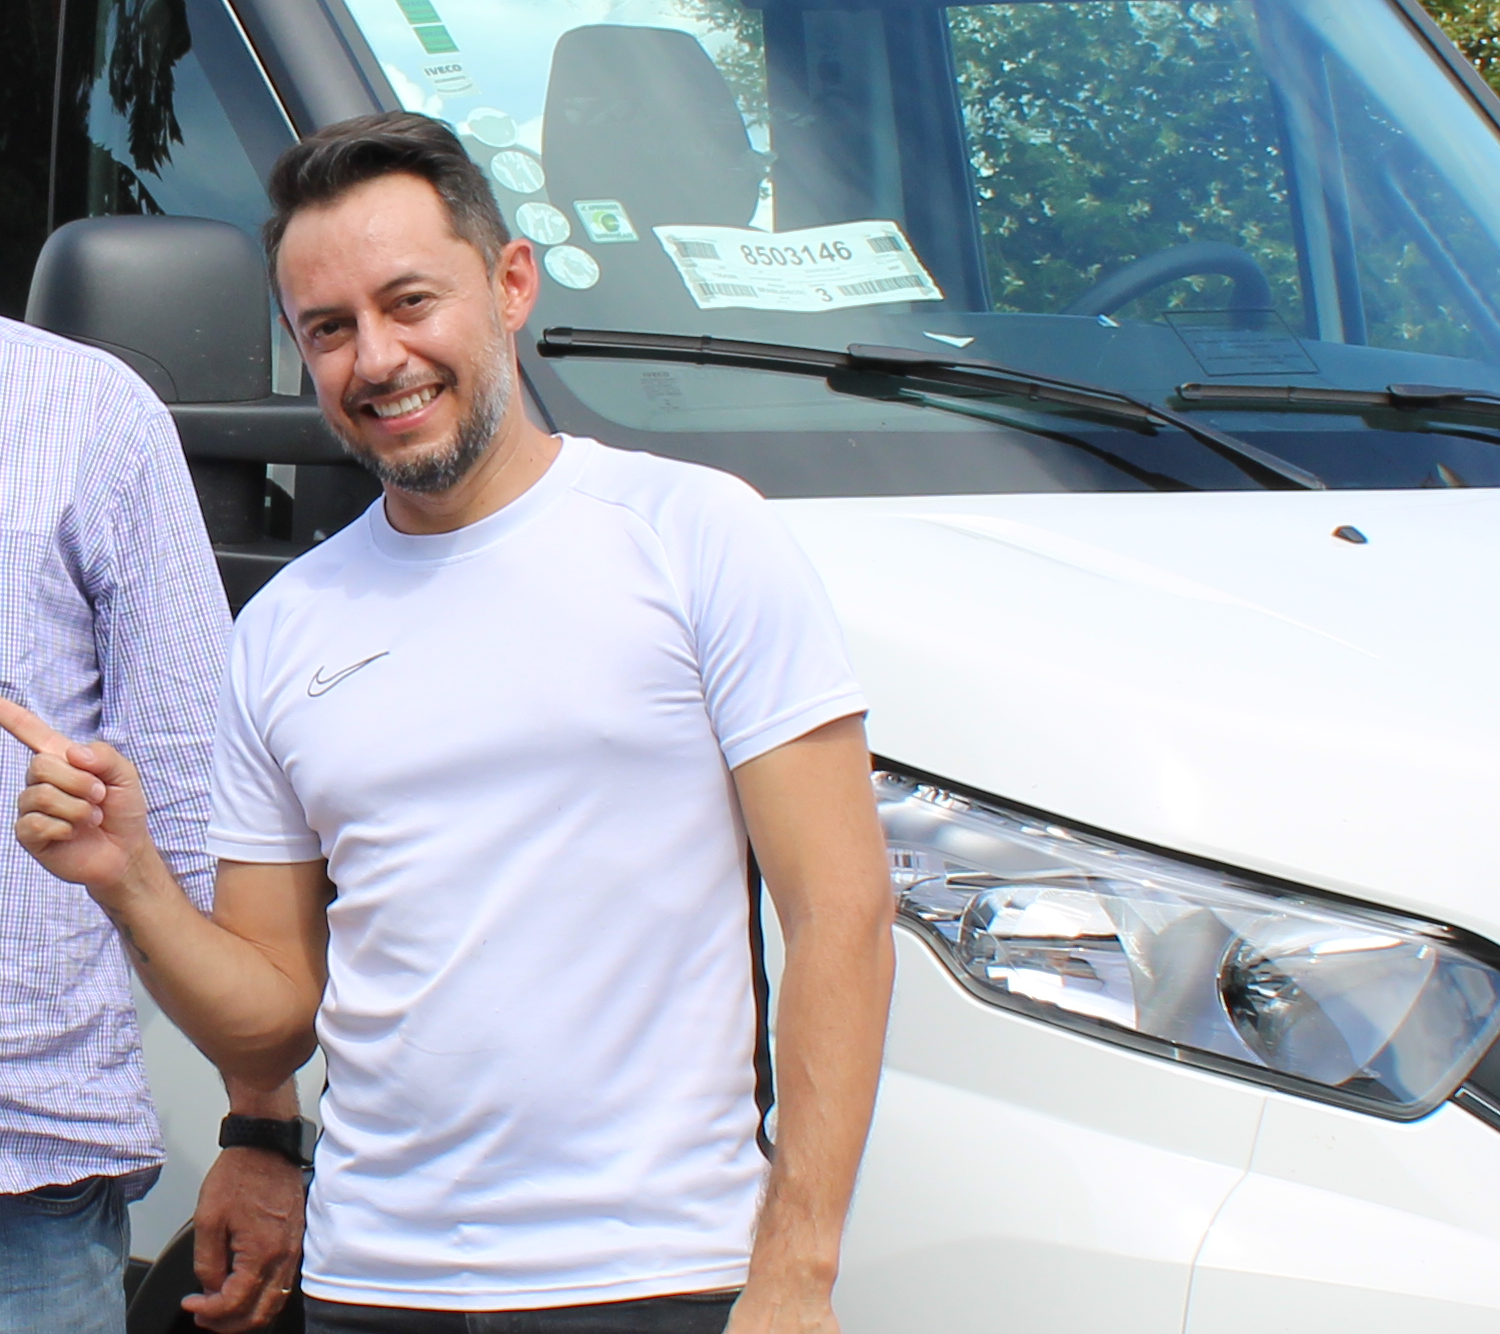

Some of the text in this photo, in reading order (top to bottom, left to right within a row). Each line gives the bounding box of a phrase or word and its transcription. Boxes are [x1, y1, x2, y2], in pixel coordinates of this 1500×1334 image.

[424, 63, 463, 77] IVECO
[740, 240, 852, 267] 8503146
[815, 287, 833, 302] 3
